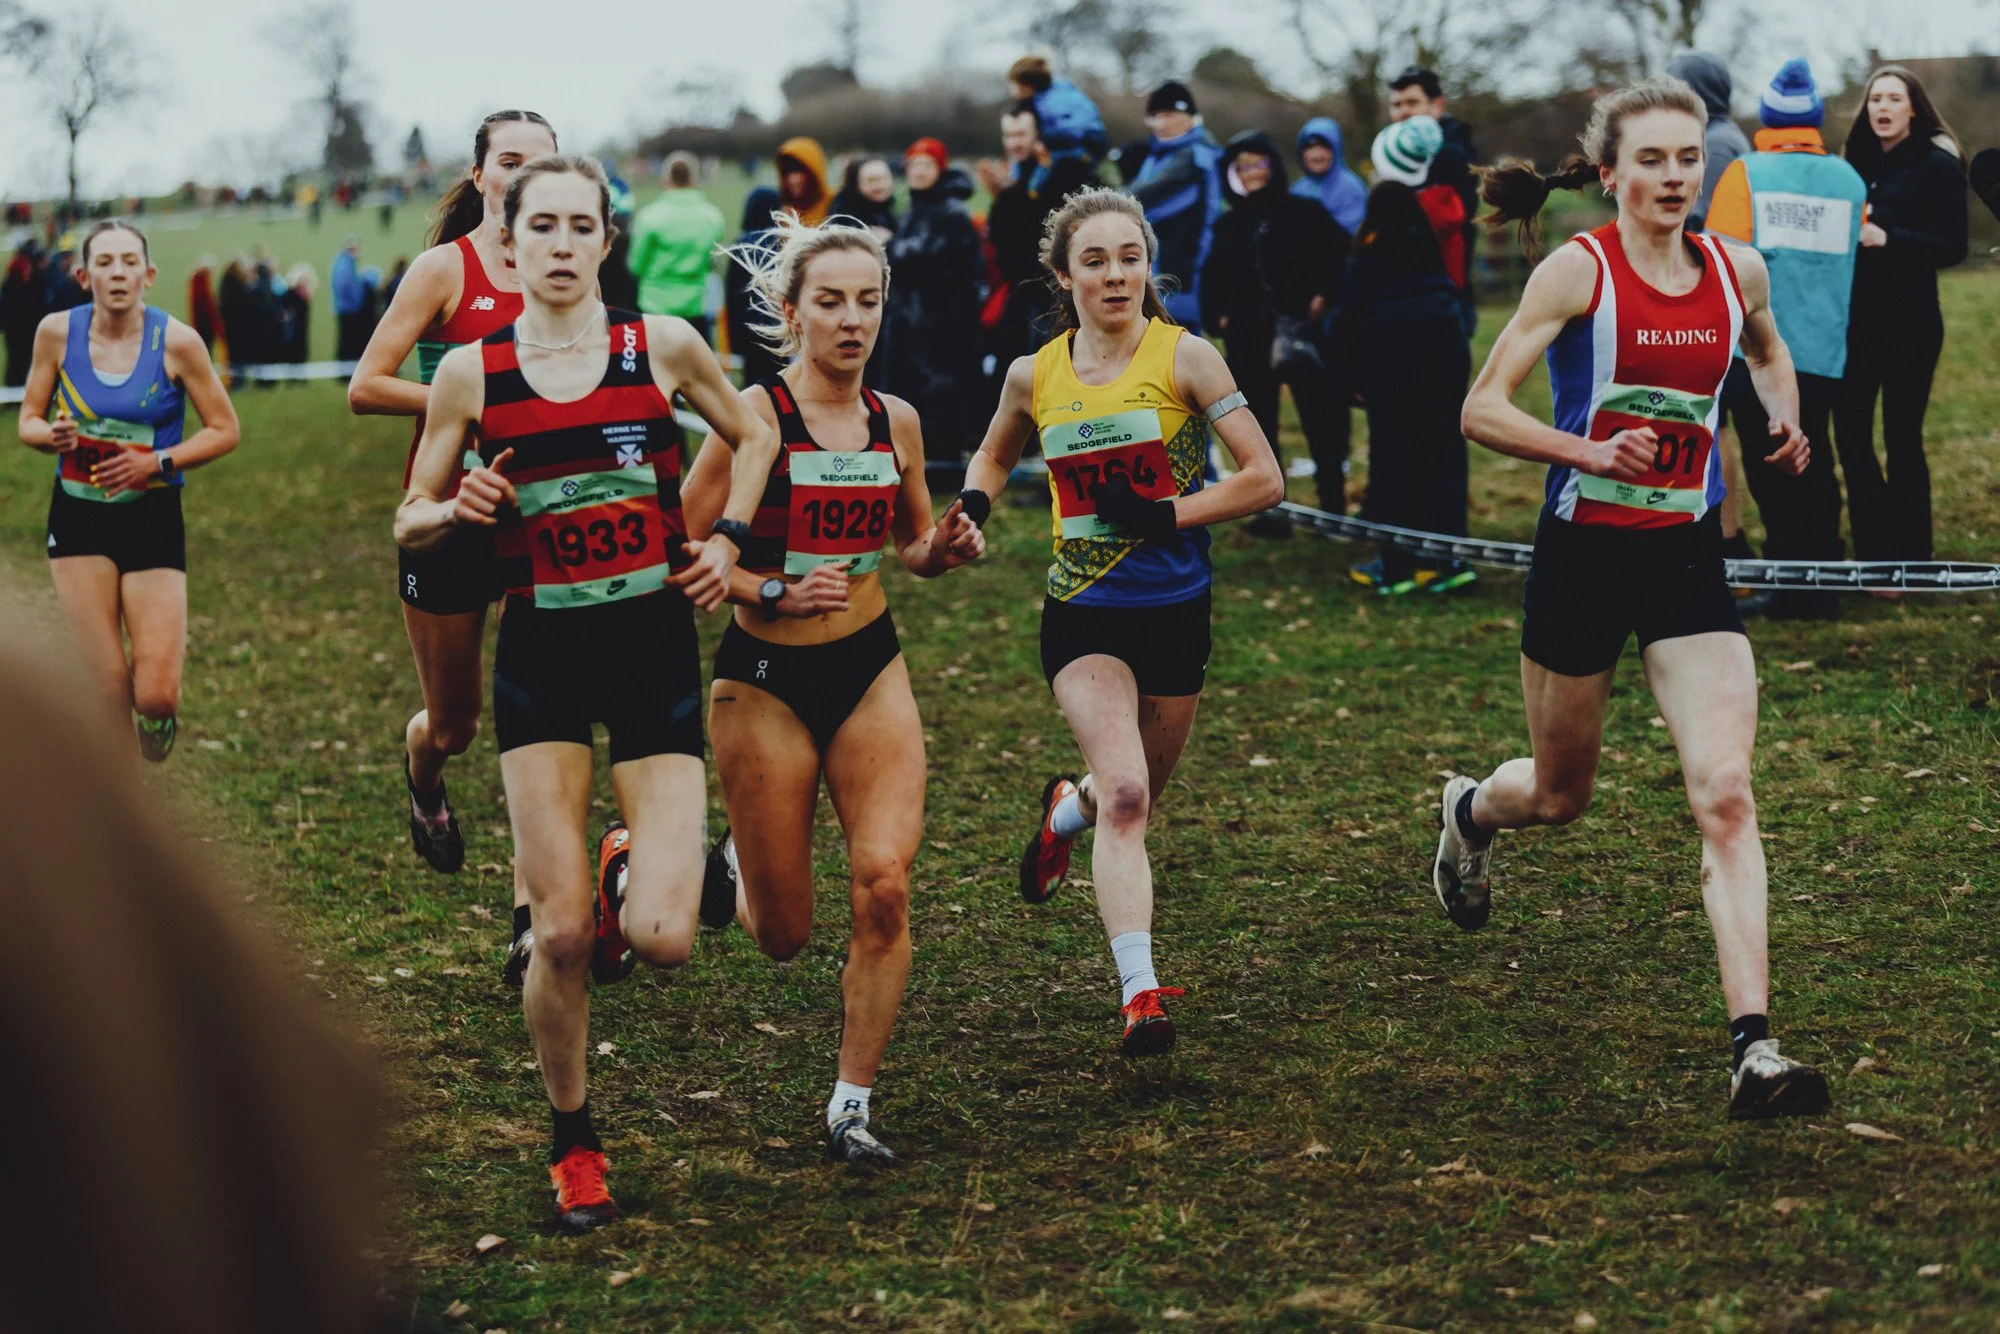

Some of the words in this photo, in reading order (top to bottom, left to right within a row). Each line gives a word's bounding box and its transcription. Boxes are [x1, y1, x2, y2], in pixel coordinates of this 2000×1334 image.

[622, 324, 637, 373] soar
[1636, 329, 1717, 345] READING
[1067, 433, 1132, 452] SEDGEFIELD
[820, 474, 879, 482] SEDGEFIELD
[803, 499, 888, 540] 1928
[538, 512, 647, 569] 1933
